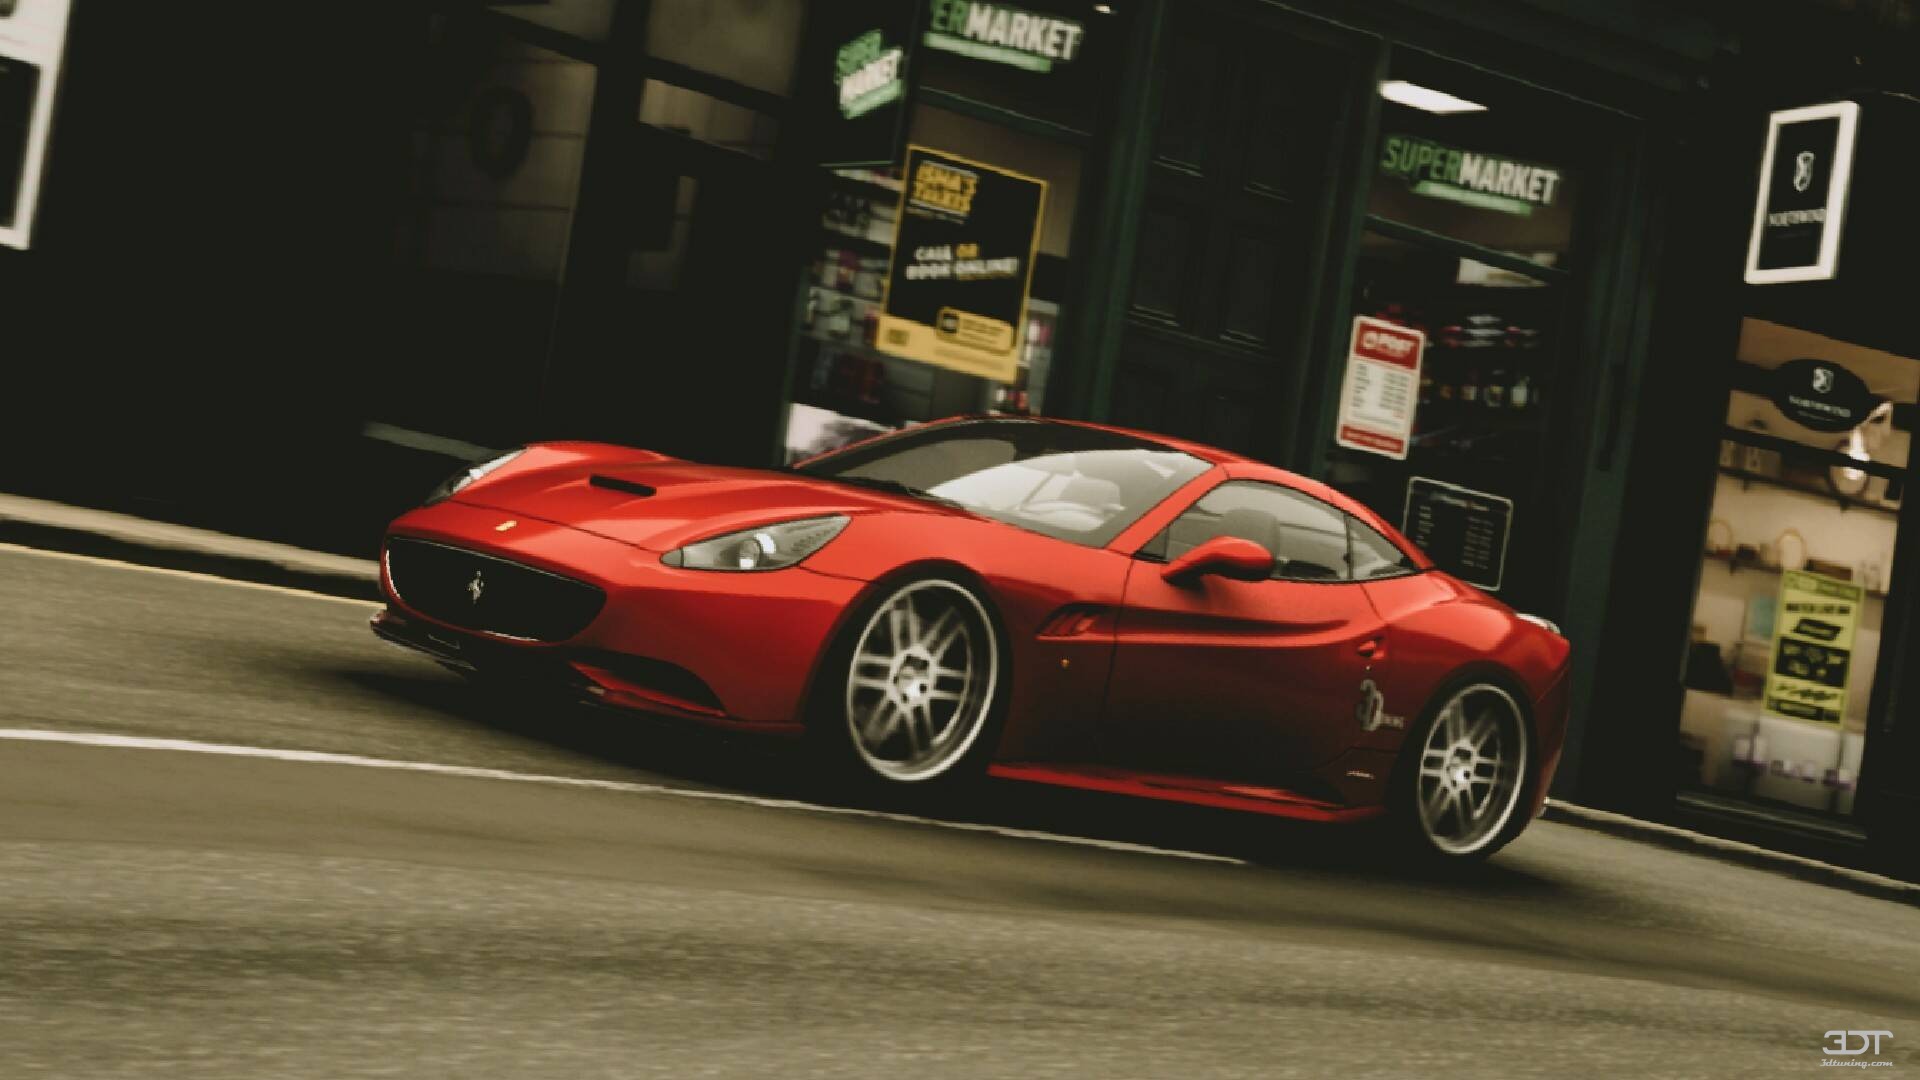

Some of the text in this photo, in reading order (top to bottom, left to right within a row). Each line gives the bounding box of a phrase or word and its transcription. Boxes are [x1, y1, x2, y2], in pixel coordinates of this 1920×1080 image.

[1382, 138, 1559, 205] SUPERMARKET
[915, 244, 978, 261] CALL OR
[907, 263, 950, 280] BOOK
